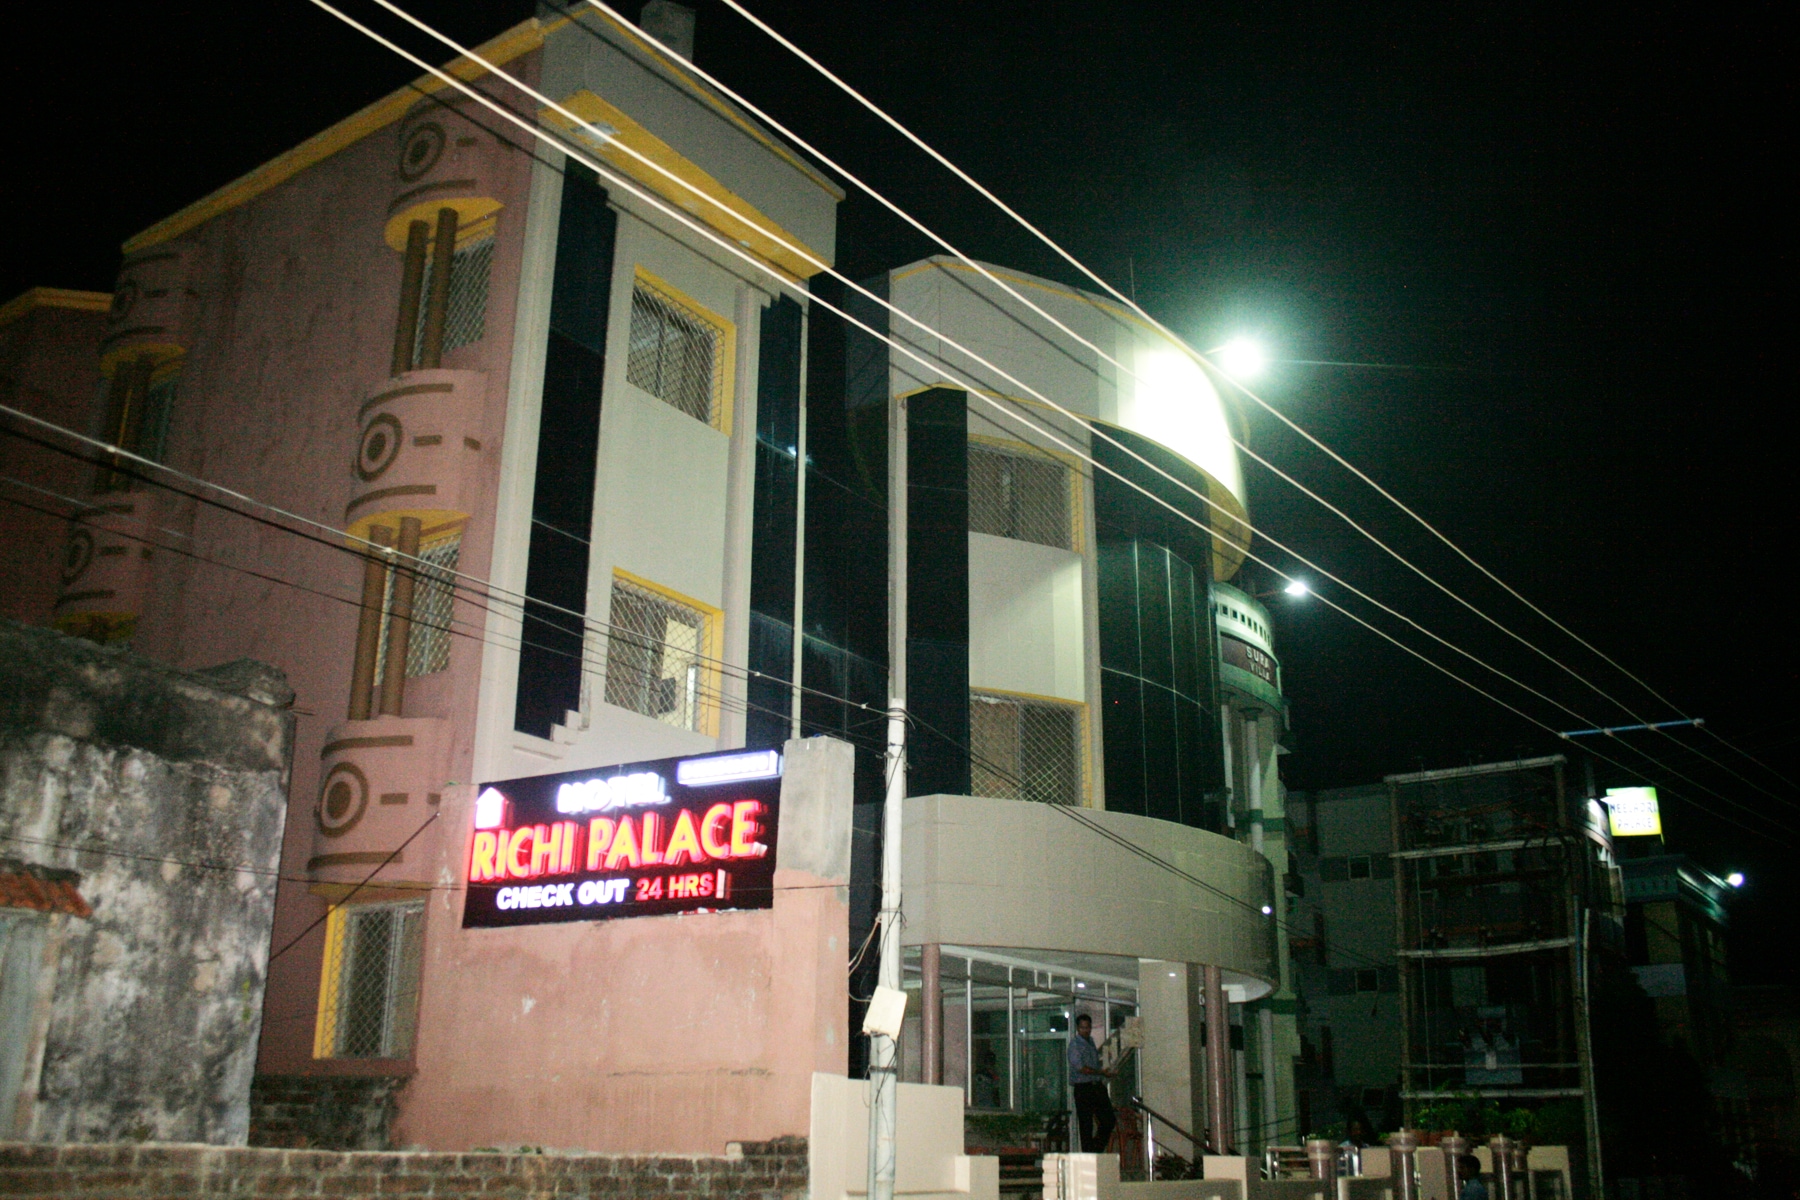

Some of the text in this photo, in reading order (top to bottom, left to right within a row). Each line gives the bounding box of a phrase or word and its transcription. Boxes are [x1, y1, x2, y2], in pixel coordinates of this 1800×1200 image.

[470, 799, 765, 882] RICHI PALACE
[496, 882, 574, 911] CHECK
[578, 878, 630, 906] OUT
[635, 878, 664, 902] 24
